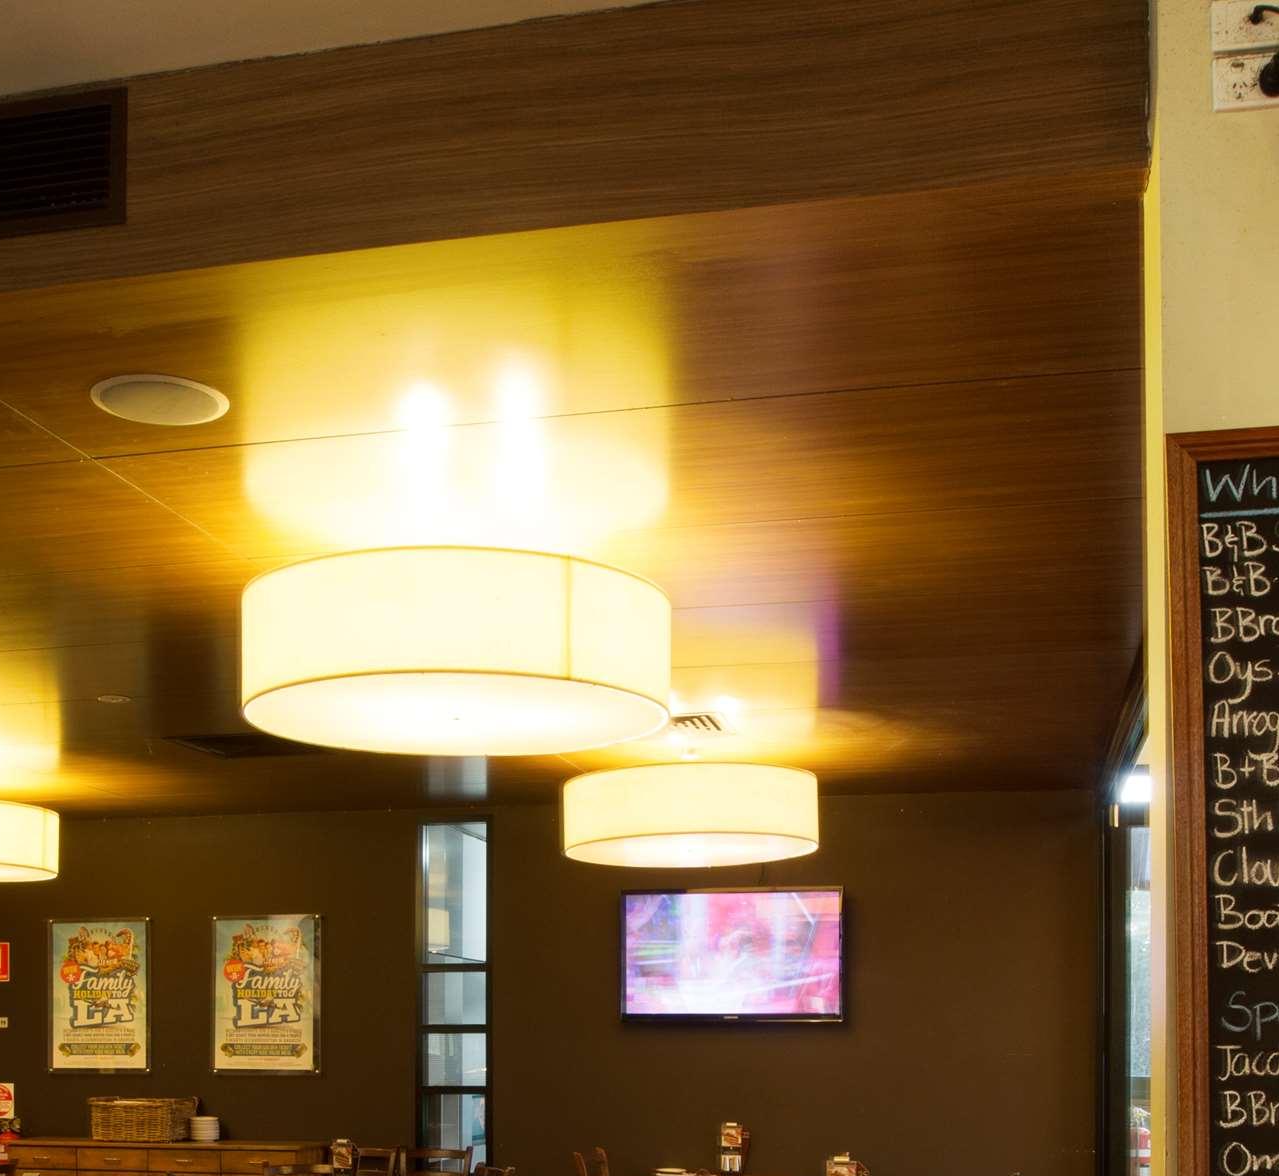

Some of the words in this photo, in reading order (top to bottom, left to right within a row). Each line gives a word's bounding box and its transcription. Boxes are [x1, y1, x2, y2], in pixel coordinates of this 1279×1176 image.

[1213, 798, 1273, 838] Sth
[73, 965, 134, 997] Family
[74, 990, 110, 999] HOLIDAY
[236, 964, 300, 996] Family
[237, 990, 276, 998] HOLIDAY
[73, 998, 134, 1027] LA
[237, 998, 300, 1026] LA
